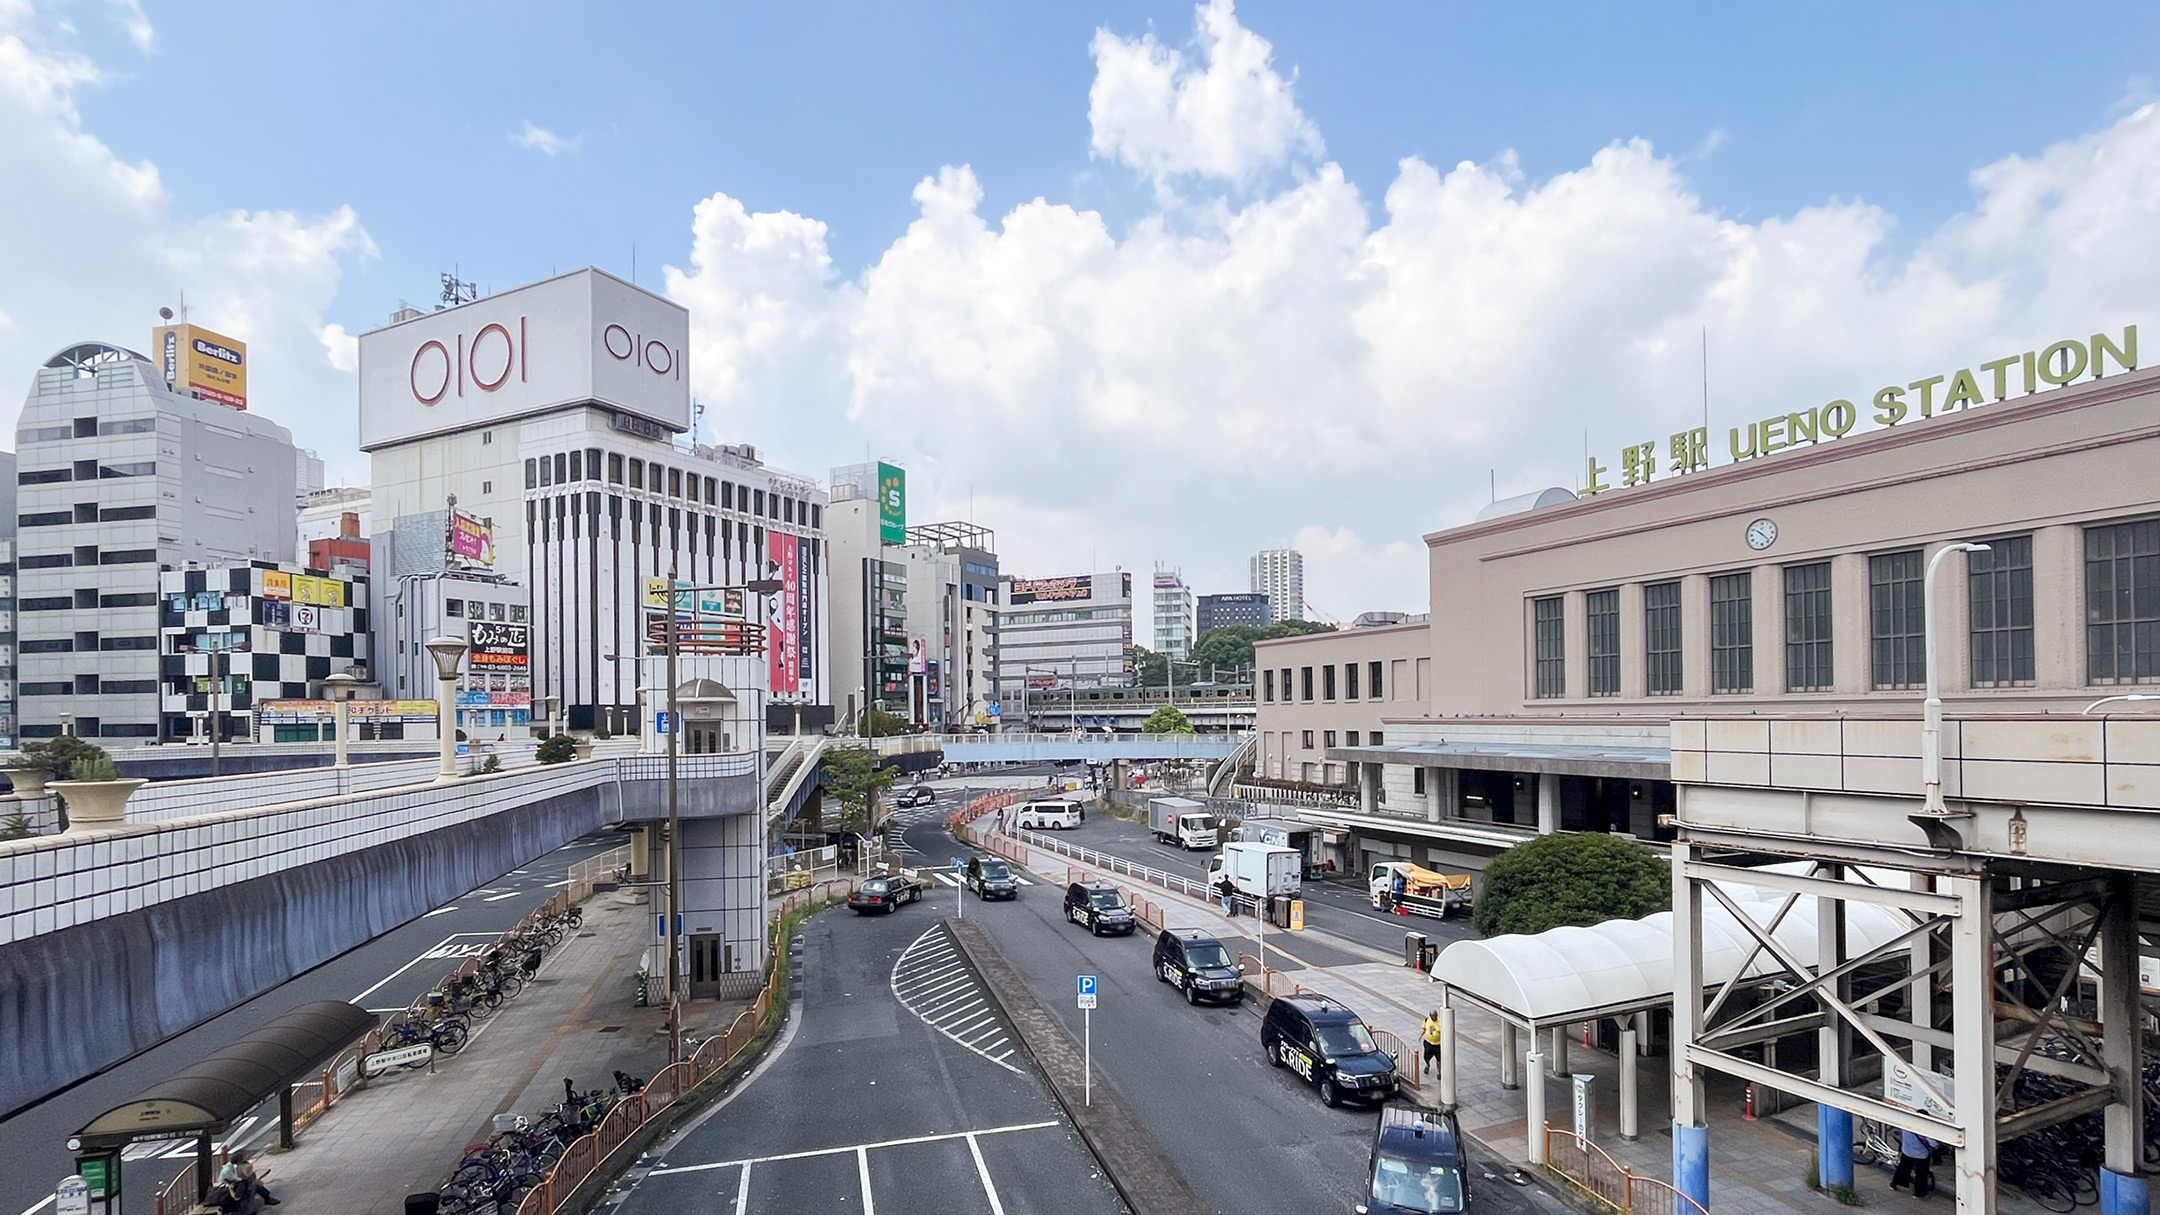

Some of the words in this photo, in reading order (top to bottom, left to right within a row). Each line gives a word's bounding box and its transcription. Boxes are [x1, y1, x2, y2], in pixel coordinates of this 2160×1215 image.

[166, 336, 176, 380] Berlitz
[196, 341, 238, 363] Berlitz
[1579, 426, 1708, 496] 上野駅
[1729, 399, 1857, 460] UENO
[1872, 324, 2138, 425] STATION
[471, 623, 527, 648] もみの匠
[472, 653, 526, 665] 全身もみほぐし
[1082, 977, 1094, 993] P
[1279, 1046, 1313, 1082] S.RIDE
